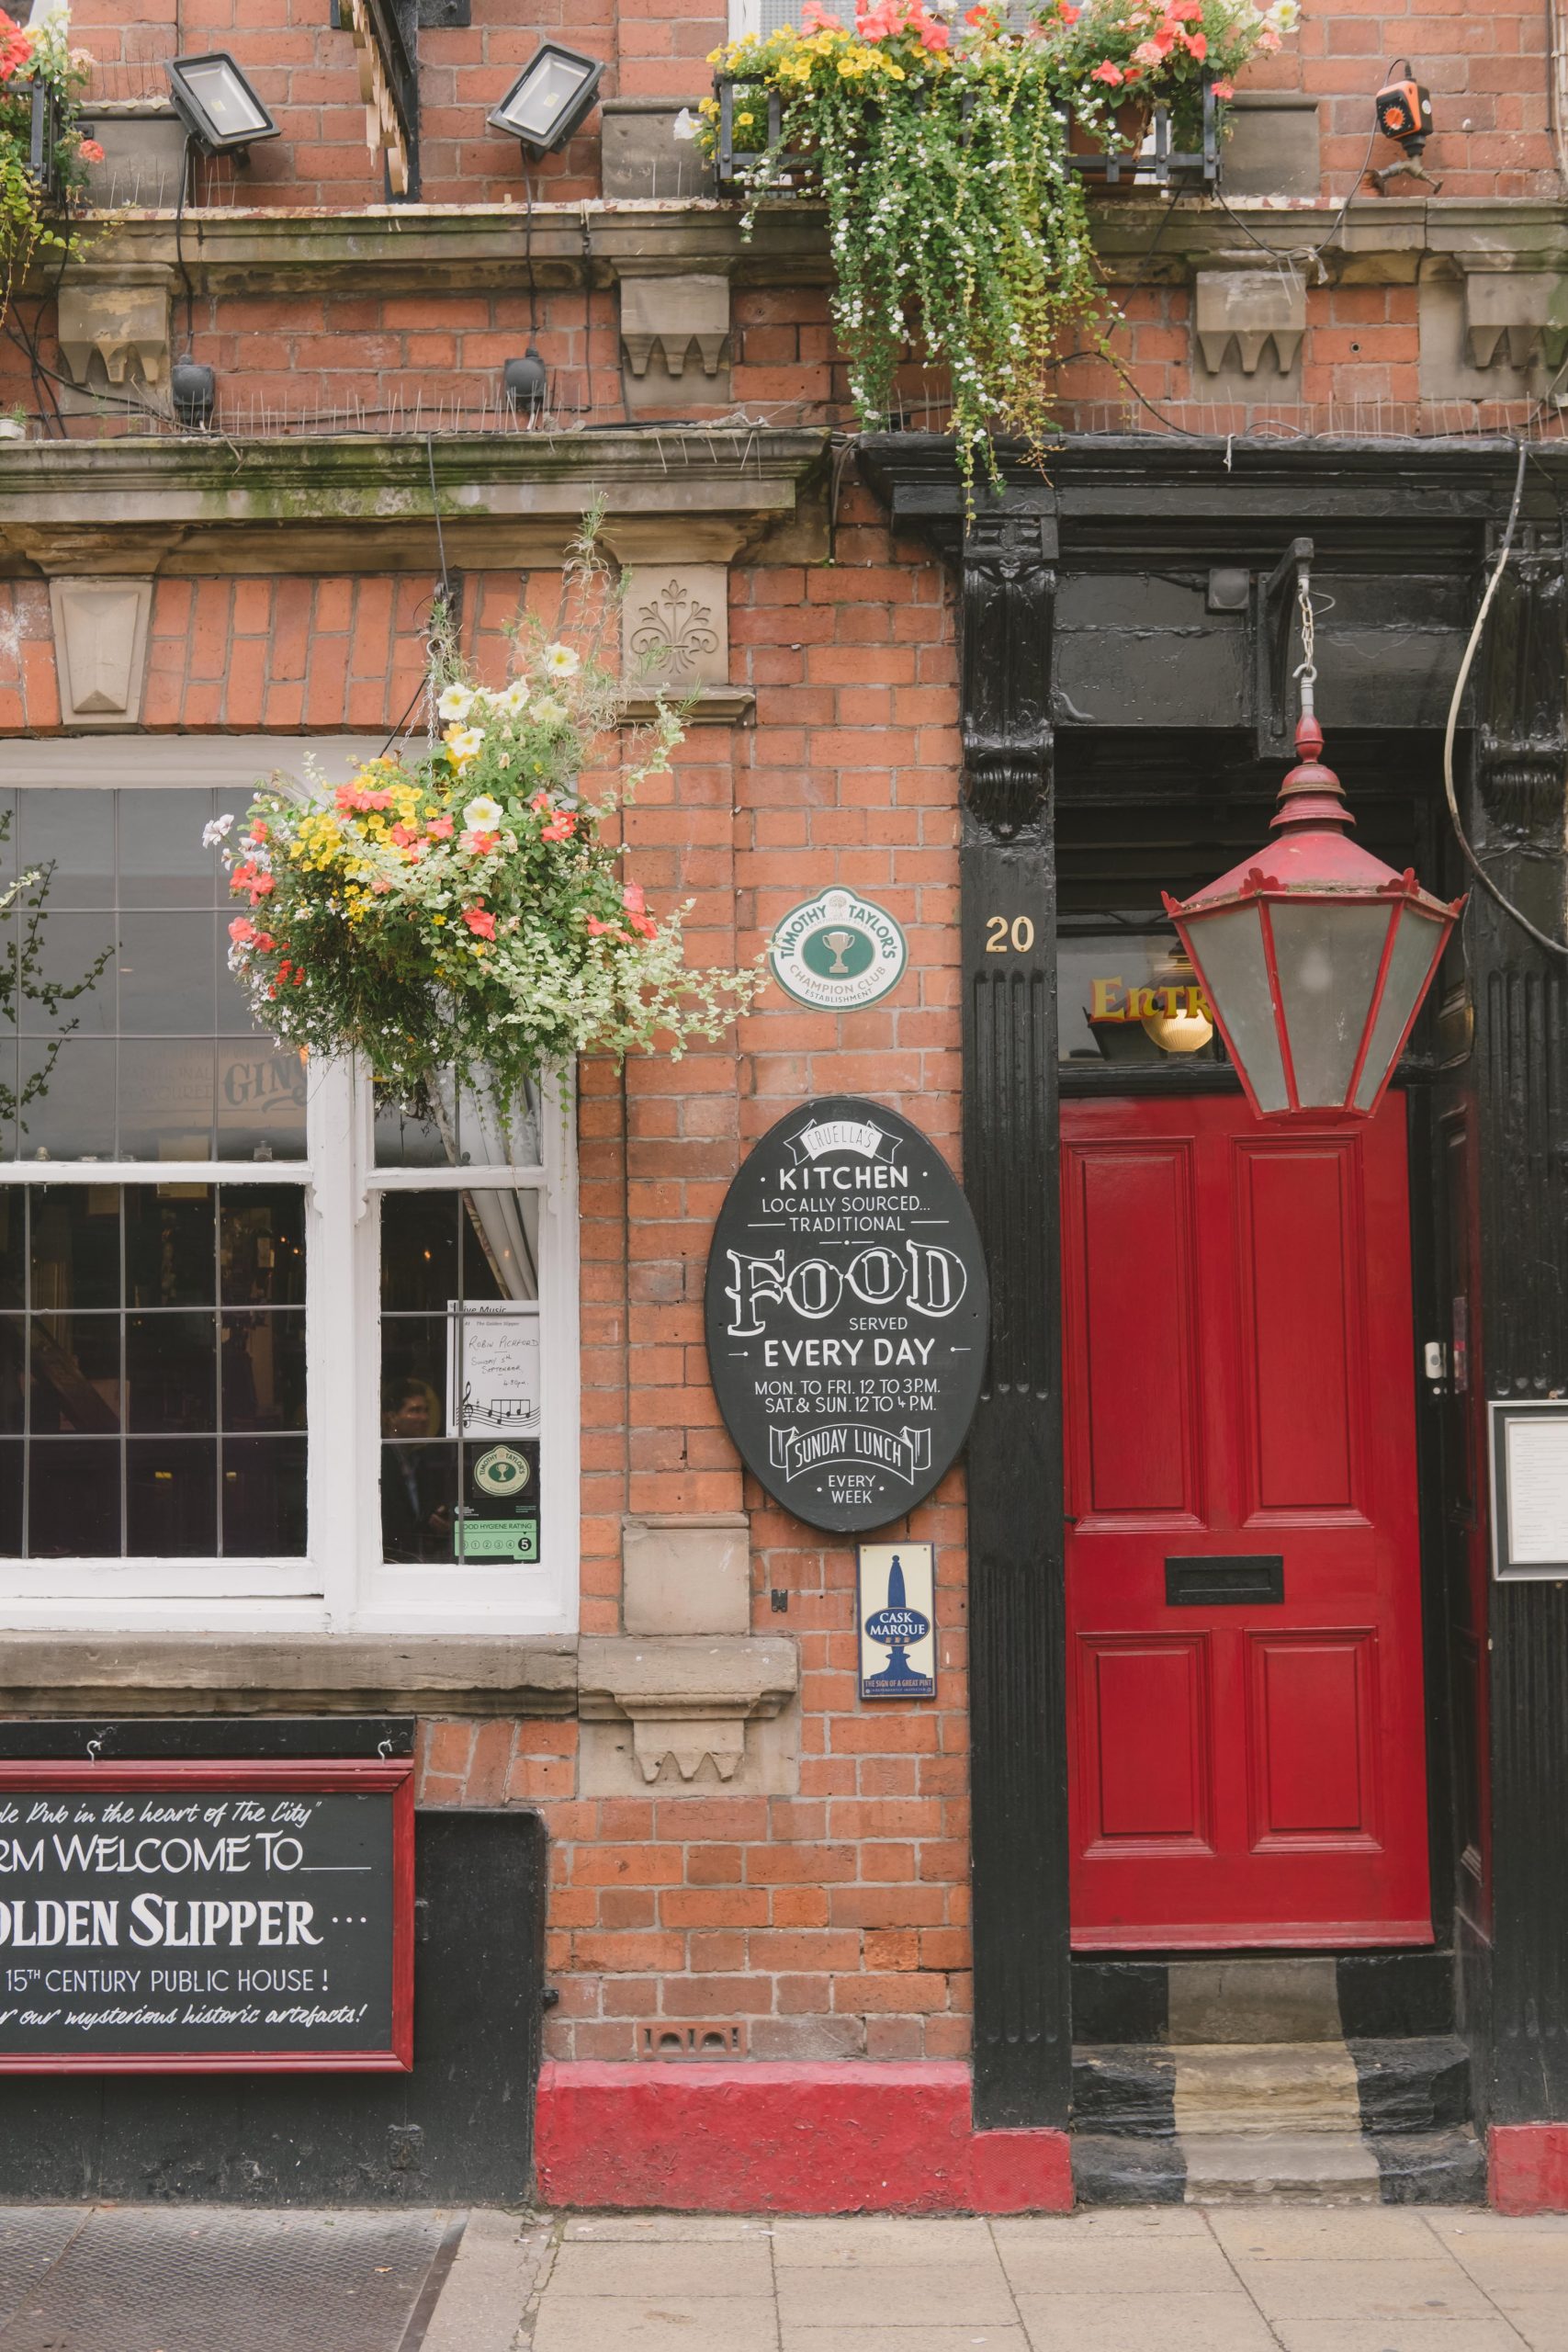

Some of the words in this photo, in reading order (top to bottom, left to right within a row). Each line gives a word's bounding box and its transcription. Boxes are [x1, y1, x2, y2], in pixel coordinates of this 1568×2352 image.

[781, 905, 827, 959] TIMOTHY
[849, 905, 898, 959] TAYLOR'S
[986, 916, 1034, 952] 20
[790, 965, 853, 995] CHAMPION
[858, 967, 886, 990] CLUB
[805, 989, 873, 1003] ESTABLISHMENT
[807, 1125, 875, 1150] CRUELLA'S
[779, 1163, 908, 1191] KITCHEN
[761, 1197, 836, 1213] LOCALLY
[841, 1196, 931, 1213] SOURCED...
[789, 1216, 906, 1232] TRADITIONAL
[725, 1238, 967, 1337] FOOD
[849, 1317, 908, 1330] SERVED
[764, 1339, 864, 1367] EVERY
[874, 1338, 936, 1365] DAY
[754, 1381, 797, 1395] MON.
[801, 1380, 822, 1395] TO
[828, 1380, 856, 1395] FRI.
[860, 1379, 874, 1394] 12
[879, 1379, 900, 1394] TO
[815, 1396, 852, 1413] SUN.
[854, 1396, 870, 1412] 12
[872, 1396, 894, 1412] TO
[795, 1429, 848, 1468] SUNDAY
[854, 1429, 902, 1467] LUNCH
[479, 1453, 498, 1476] TIMOTHY
[828, 1475, 876, 1487] EVERY
[831, 1489, 873, 1503] WEEK
[521, 1539, 529, 1550] 5
[879, 1612, 913, 1623] CASK
[870, 1623, 926, 1636] MARQUE
[897, 1679, 902, 1687] A
[26, 1801, 69, 1824] Pub
[73, 1803, 96, 1824] in
[101, 1801, 135, 1824] the
[139, 1801, 200, 1824] heart
[204, 1802, 229, 1827] of
[231, 1800, 266, 1822] The
[52, 1833, 251, 1873] WELCOME
[255, 1830, 303, 1871] TO
[130, 1893, 323, 1947] SLIPPER
[6, 1969, 40, 1992] 15TH
[46, 1969, 141, 1992] CENTURY
[151, 1969, 229, 1992] PUBLIC
[19, 2009, 62, 2025] our
[64, 2005, 178, 2030] mysterious
[181, 2004, 261, 2024] historic
[265, 2003, 368, 2028] artefacts!
